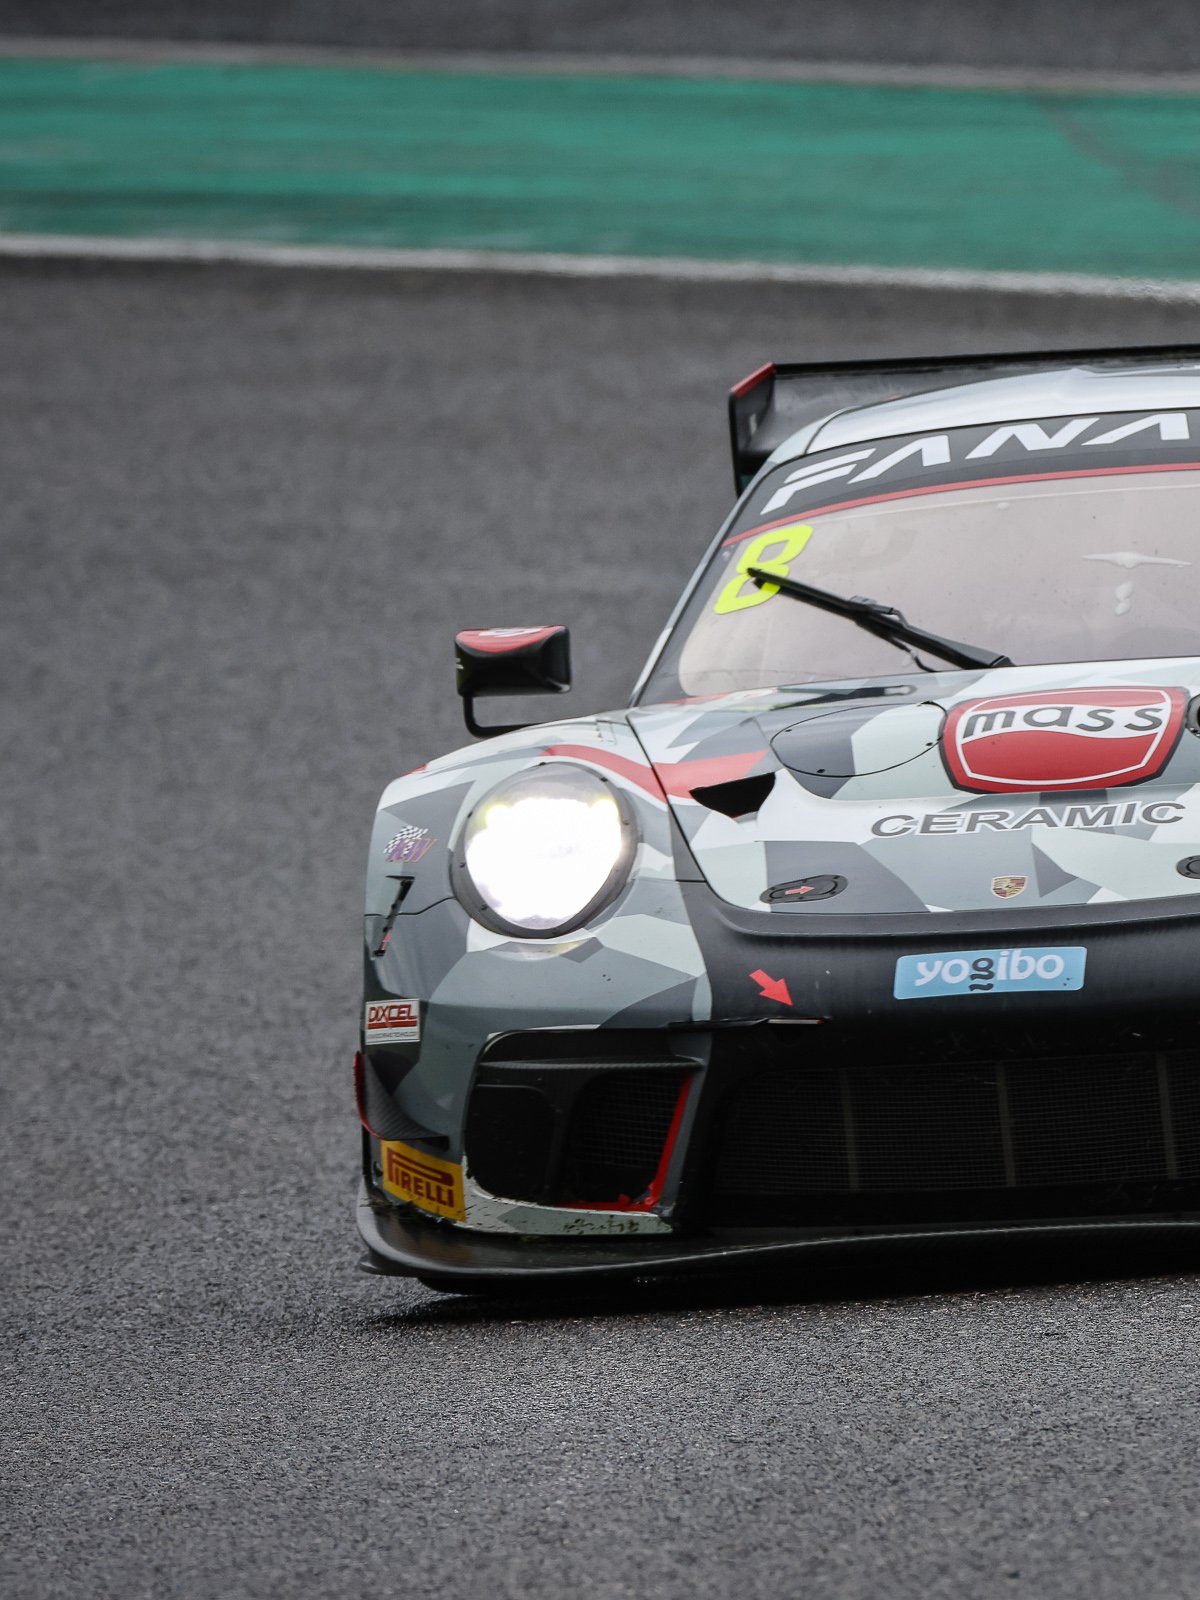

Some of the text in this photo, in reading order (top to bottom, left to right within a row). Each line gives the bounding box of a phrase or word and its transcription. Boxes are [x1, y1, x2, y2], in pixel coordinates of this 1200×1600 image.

[714, 525, 813, 614] 8
[963, 704, 1165, 739] mass
[871, 801, 1186, 838] CERAMIC
[914, 947, 1065, 992] yogibo
[368, 1004, 417, 1022] DIXCEL
[387, 1147, 455, 1208] PIRELLI
